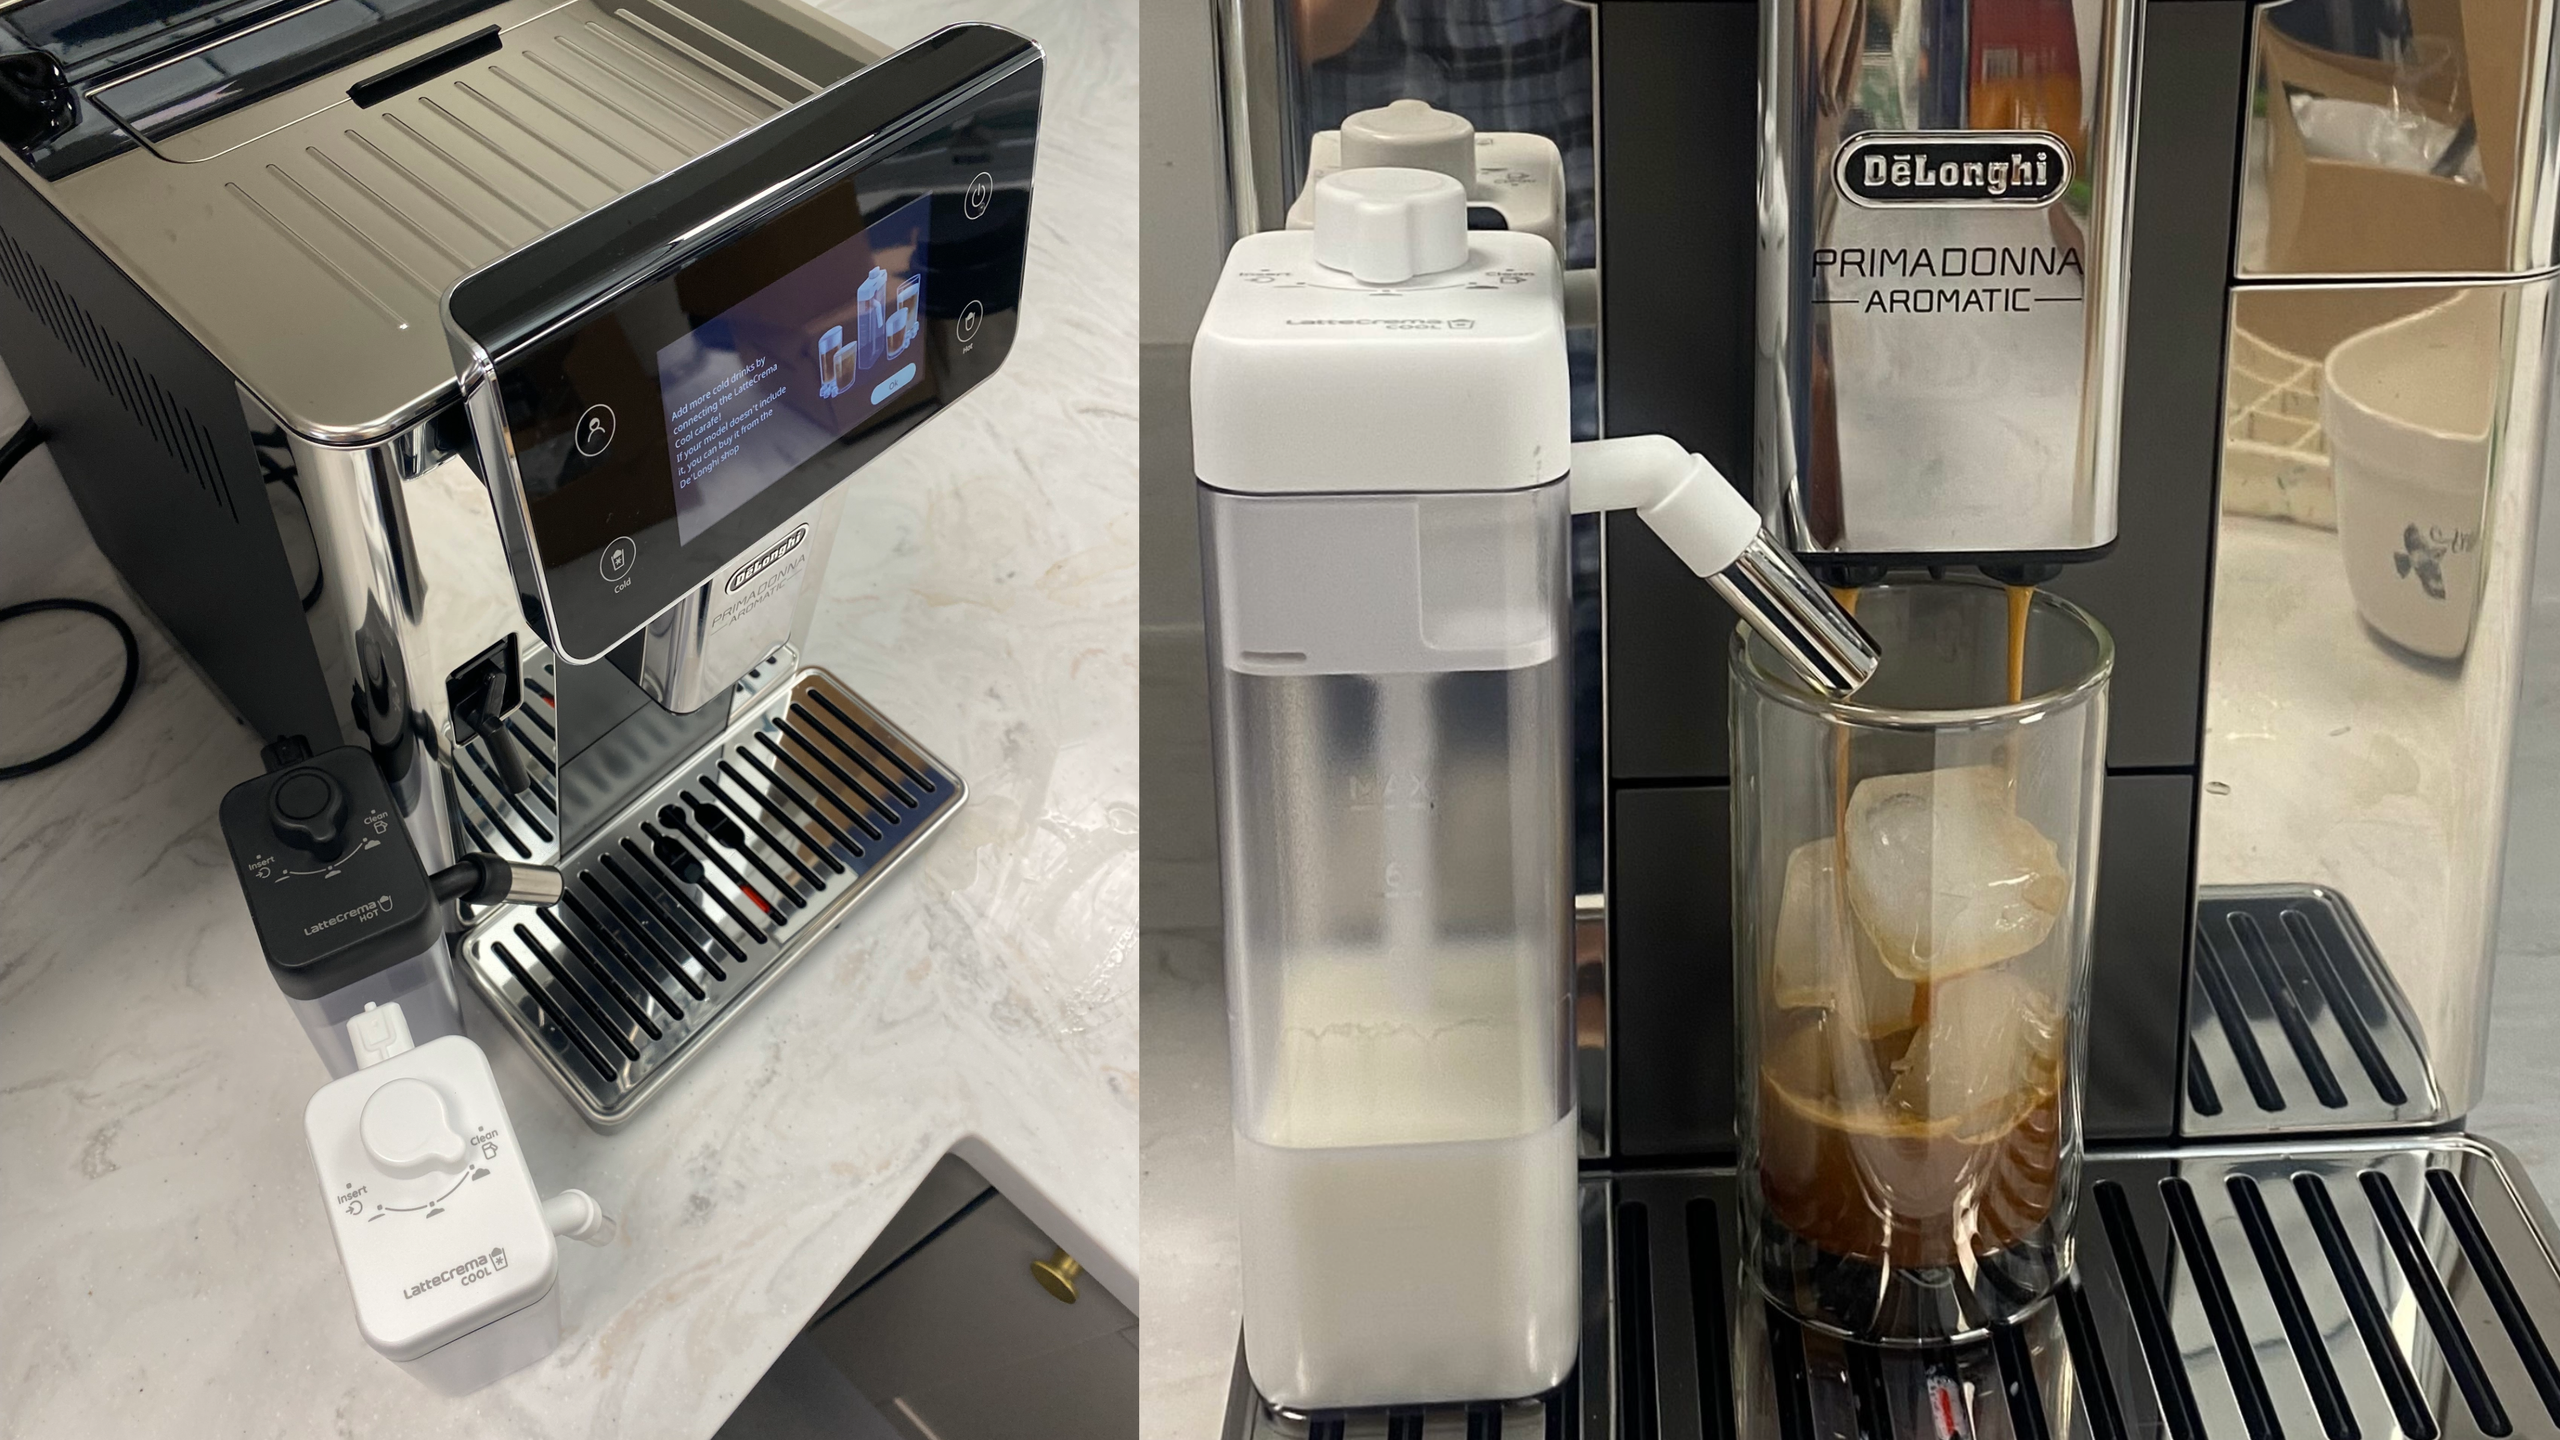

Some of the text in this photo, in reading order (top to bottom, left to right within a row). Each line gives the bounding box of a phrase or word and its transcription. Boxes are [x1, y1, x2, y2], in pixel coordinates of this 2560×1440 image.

[1811, 247, 2085, 278] PRIMADONNA
[1865, 288, 2031, 313] AROMATIC
[962, 343, 973, 354] Hot
[671, 357, 766, 421] Add more cold drinks by
[673, 363, 778, 435] connecting the LatteCrema
[889, 380, 899, 391] Ok
[675, 413, 722, 449] Cool carafe!
[676, 386, 787, 463] If your model doesn't include
[678, 408, 773, 476] it, you can buy it from the
[680, 445, 740, 489] De'Longhi shop
[614, 577, 632, 594] Cold
[711, 554, 806, 628] PRIMADONNA
[728, 578, 787, 626] AROMATIC
[364, 810, 389, 826] Clean
[248, 856, 275, 871] Insert
[359, 908, 380, 923] HOT
[470, 1128, 499, 1147] Clean
[337, 1185, 368, 1205] Insert
[403, 1254, 488, 1300] LatteCrema
[461, 1266, 492, 1287] COOL
